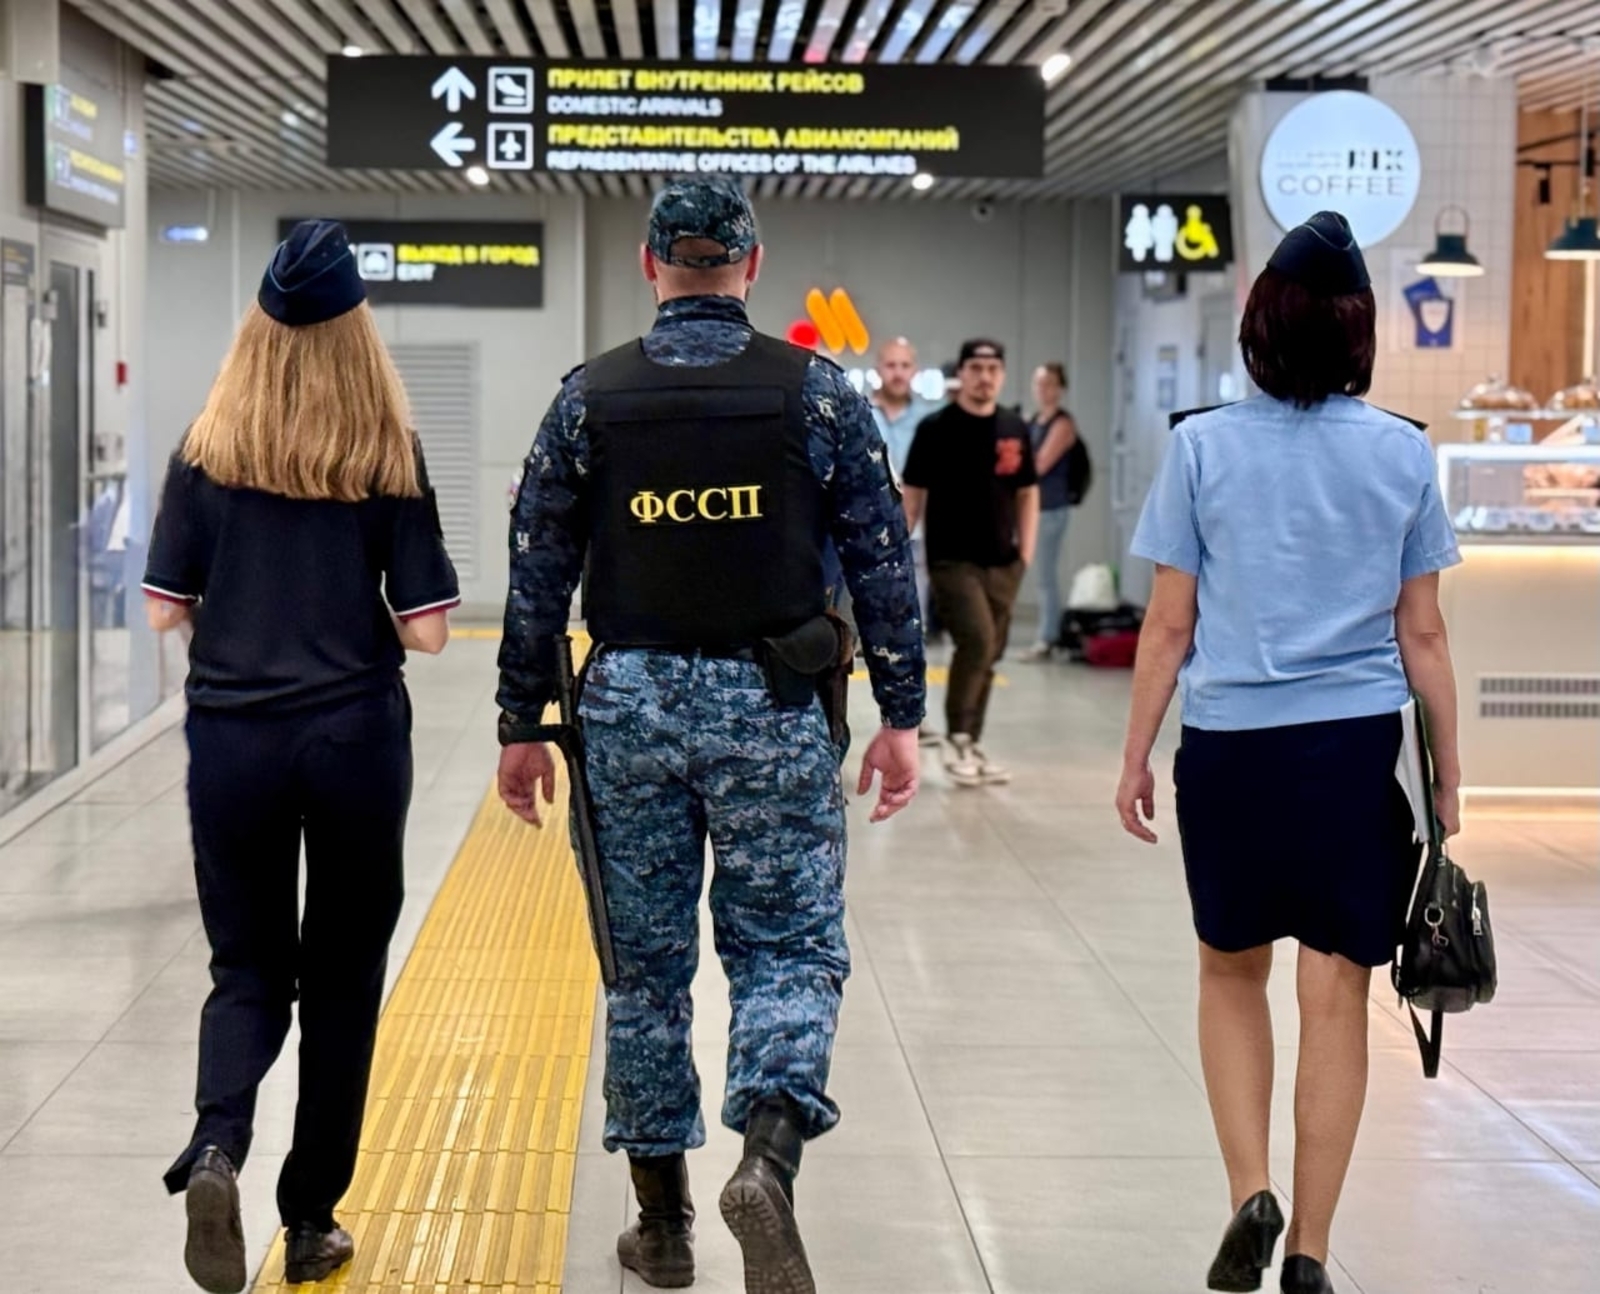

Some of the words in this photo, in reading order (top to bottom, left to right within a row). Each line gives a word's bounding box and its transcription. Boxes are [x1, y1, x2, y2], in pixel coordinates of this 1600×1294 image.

[547, 68, 632, 89] ПРИЛЕТ
[634, 69, 774, 92] ВНУТРЕННИХ
[776, 68, 864, 93] РЕЙСОВ
[546, 95, 638, 115] DOMESTIC
[638, 97, 723, 117] ARRIVALS
[547, 123, 780, 149] ПРЕДСТАВИТЕЛЬСТВА
[782, 125, 960, 151] АВИАКОМПАНИЙ
[546, 151, 696, 171] REPRESENTATIVE
[697, 153, 772, 173] OFFICES
[773, 154, 800, 173] OF
[801, 154, 836, 174] THE
[837, 154, 917, 175] AIRLINES
[1277, 174, 1404, 196] COFFEE
[630, 485, 764, 523] ФССП
